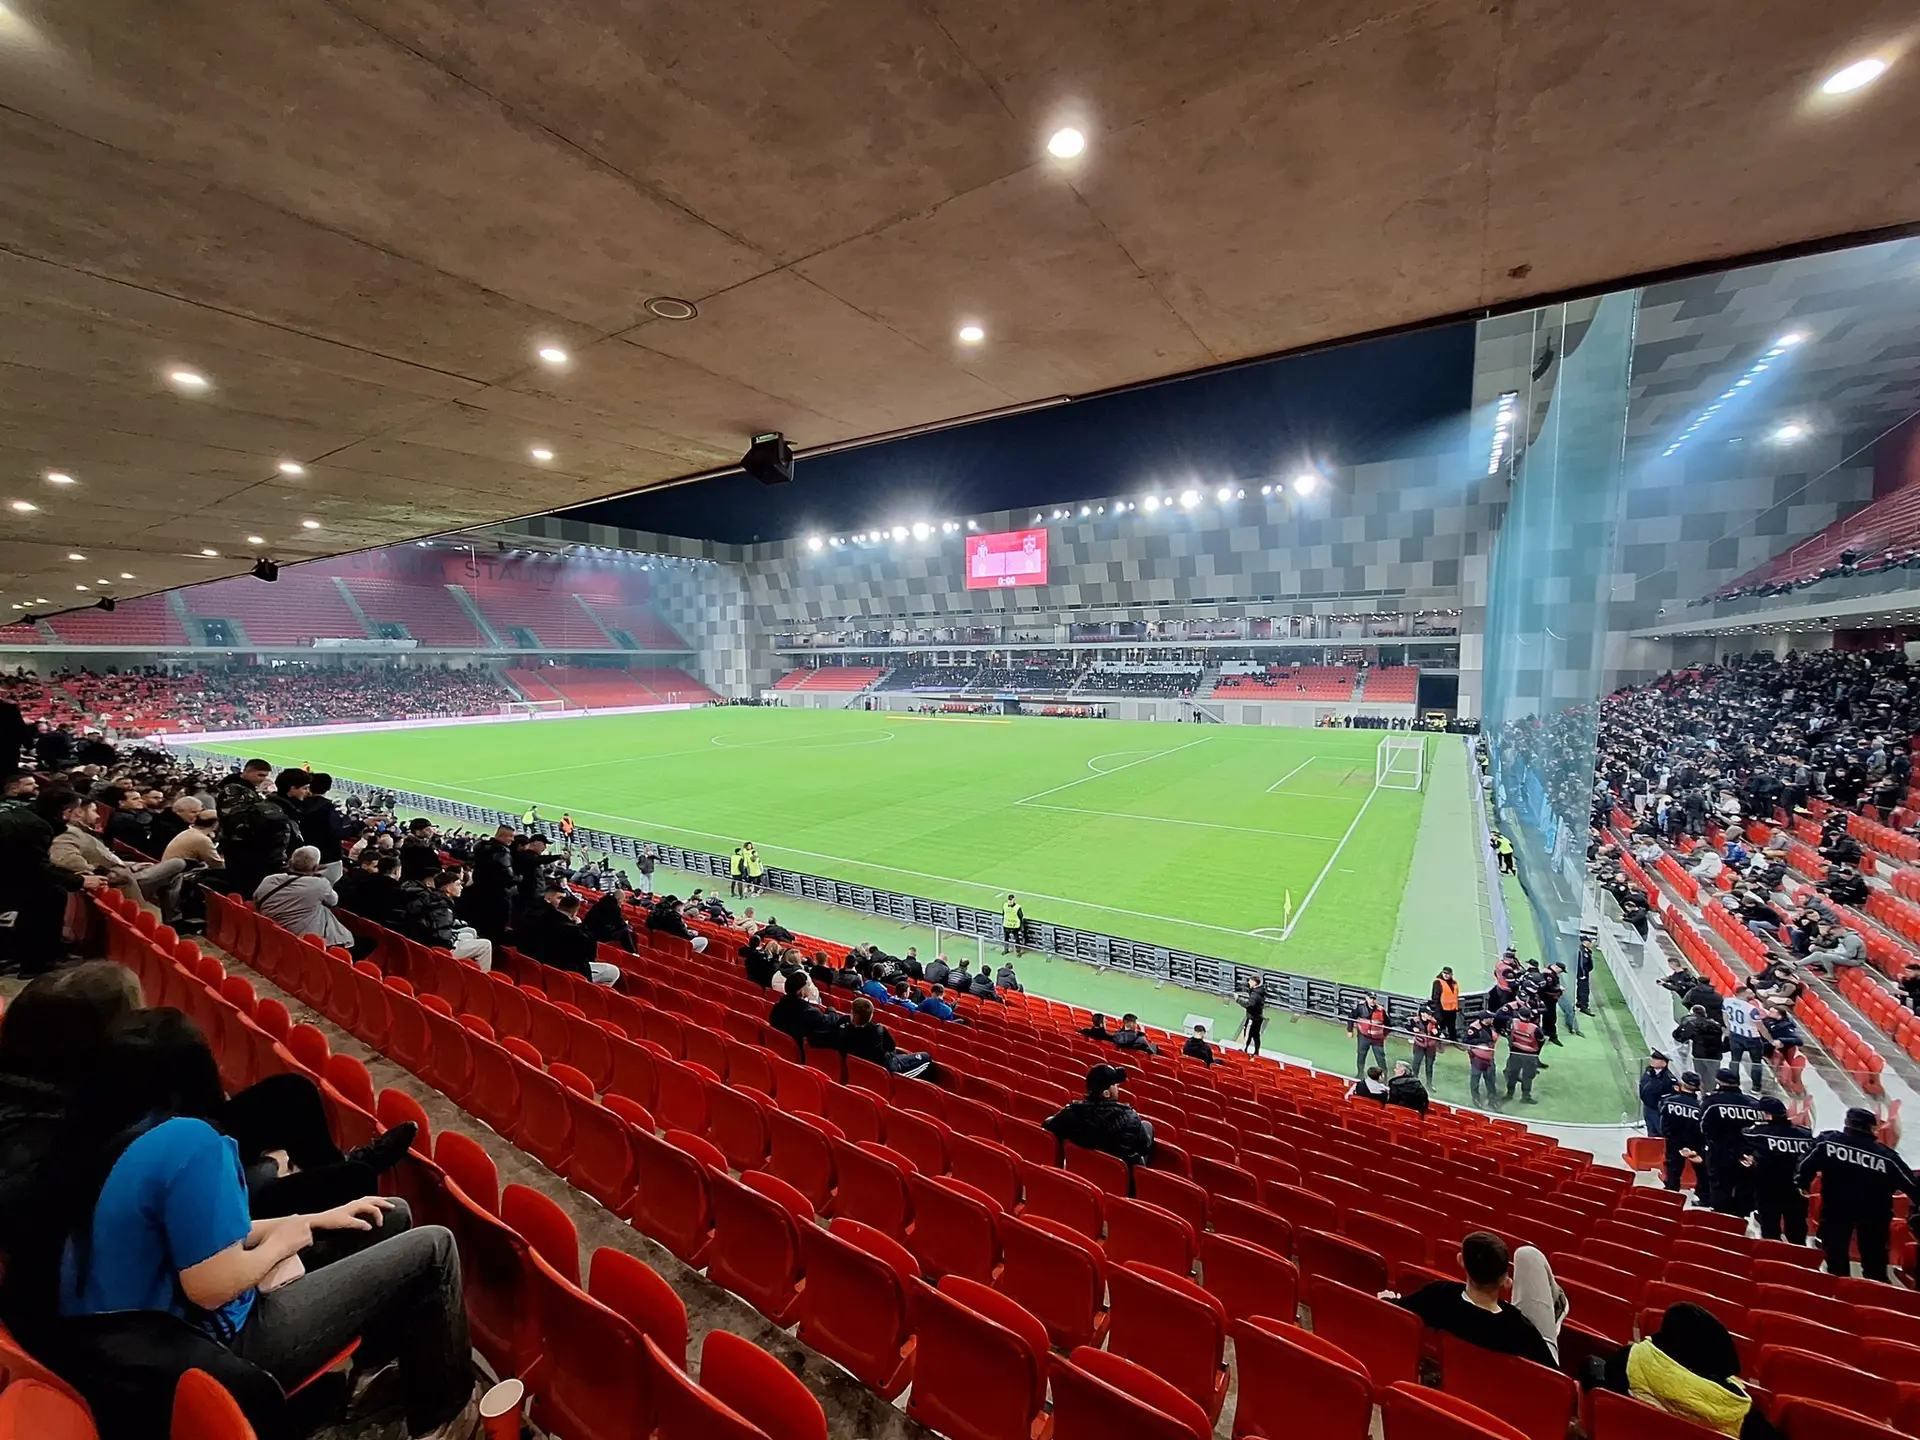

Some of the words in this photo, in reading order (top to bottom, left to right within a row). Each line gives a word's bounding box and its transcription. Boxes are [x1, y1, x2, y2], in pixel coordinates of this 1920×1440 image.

[1726, 1005, 1745, 1025] 30
[1667, 1103, 1700, 1121] POLIC
[1826, 1143, 1888, 1174] POLICIA
